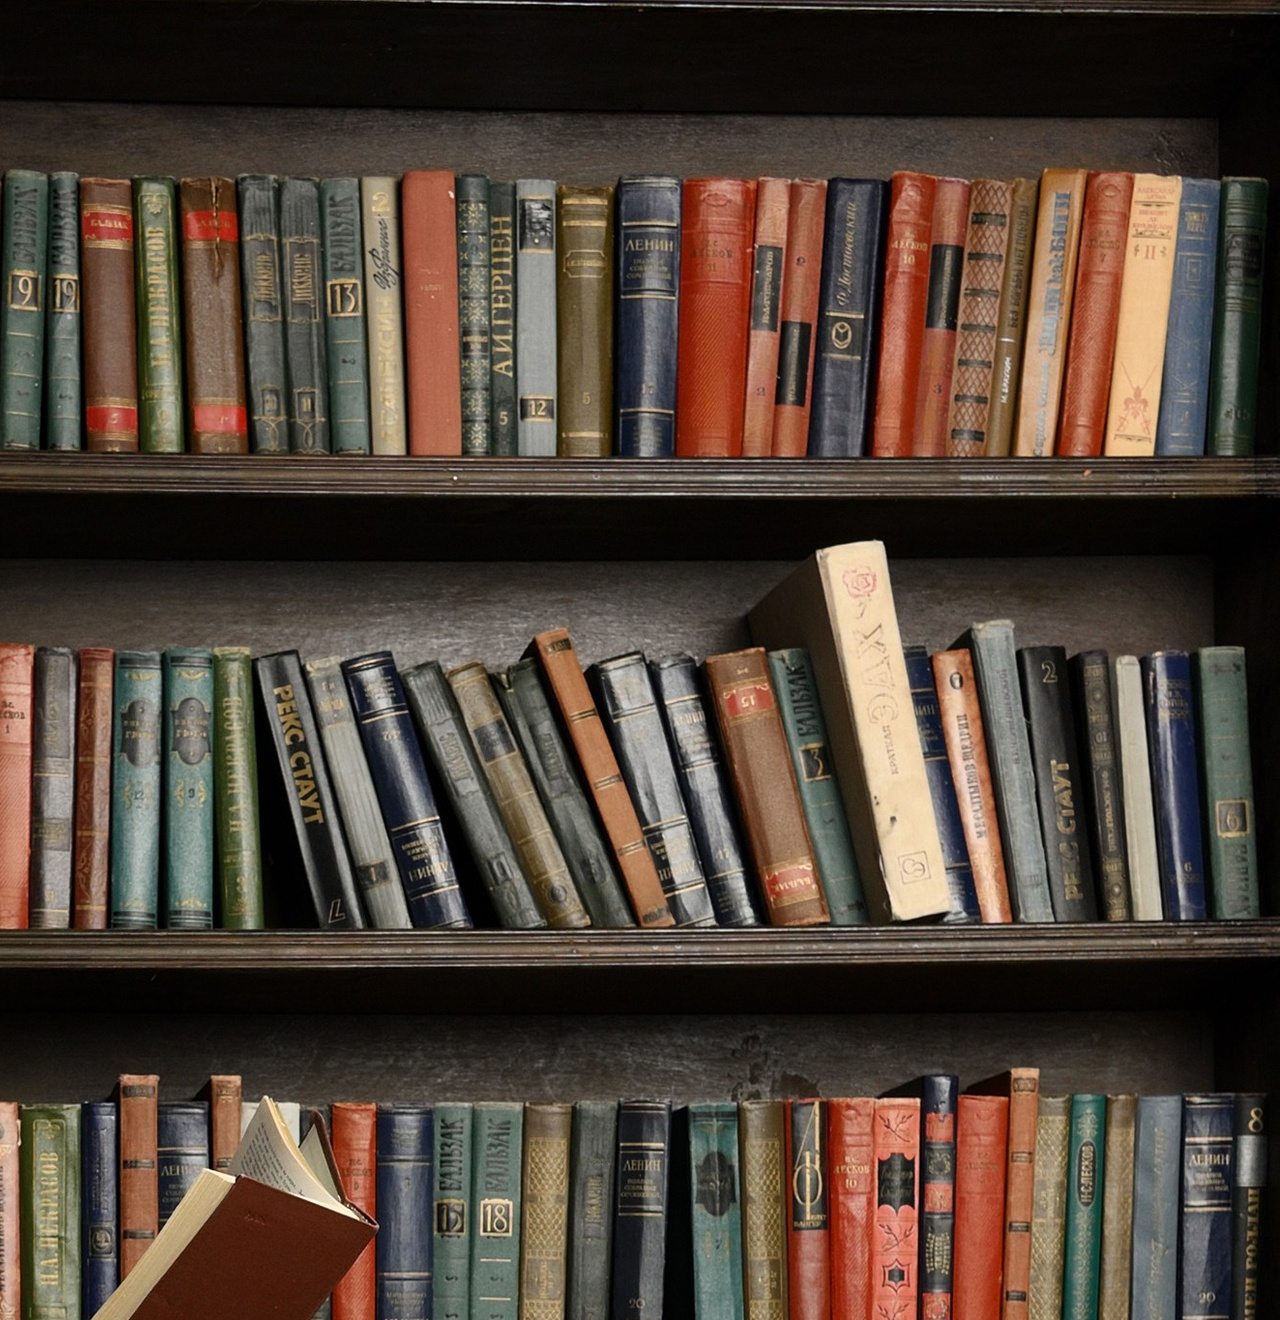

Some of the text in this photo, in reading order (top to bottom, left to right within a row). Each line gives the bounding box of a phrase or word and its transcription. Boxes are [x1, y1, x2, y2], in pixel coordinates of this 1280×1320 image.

[337, 195, 358, 273] БАЛЬЗАК
[1050, 189, 1071, 252] БОГИ
[625, 238, 674, 253] ЛЕНИН
[1144, 243, 1157, 261] II
[18, 276, 34, 307] 9
[146, 226, 167, 328] НЕКРАСОВ
[55, 279, 78, 309] 19
[331, 284, 356, 313] 13
[528, 400, 547, 416] 12
[582, 392, 591, 406] 5
[498, 411, 508, 425] 5
[1040, 660, 1058, 685] 2
[740, 694, 757, 707] 15
[786, 663, 819, 746] БАЛЬЗАК
[223, 696, 244, 797] НЕКРАСОВ
[273, 684, 325, 826] РЕКС СТАУТ
[809, 749, 824, 778] 3
[187, 788, 196, 799] 9
[1051, 759, 1076, 834] СТАУТ
[1247, 1106, 1264, 1134] 8
[440, 1118, 465, 1192] БАЛЬЗАК
[486, 1119, 512, 1195] БАЛЬЗАК
[622, 1158, 662, 1172] ЛЕНИН
[833, 1164, 871, 1175] ЛЕСКОВ
[1188, 1153, 1231, 1167] ЛЕНИН
[844, 1178, 858, 1190] 10
[39, 1150, 61, 1287] Н.А. НЕКРАСОВ
[485, 1203, 510, 1233] 18
[1244, 1187, 1261, 1271] РОЛЛАН
[627, 1298, 646, 1310] 20
[1198, 1292, 1217, 1305] 20
